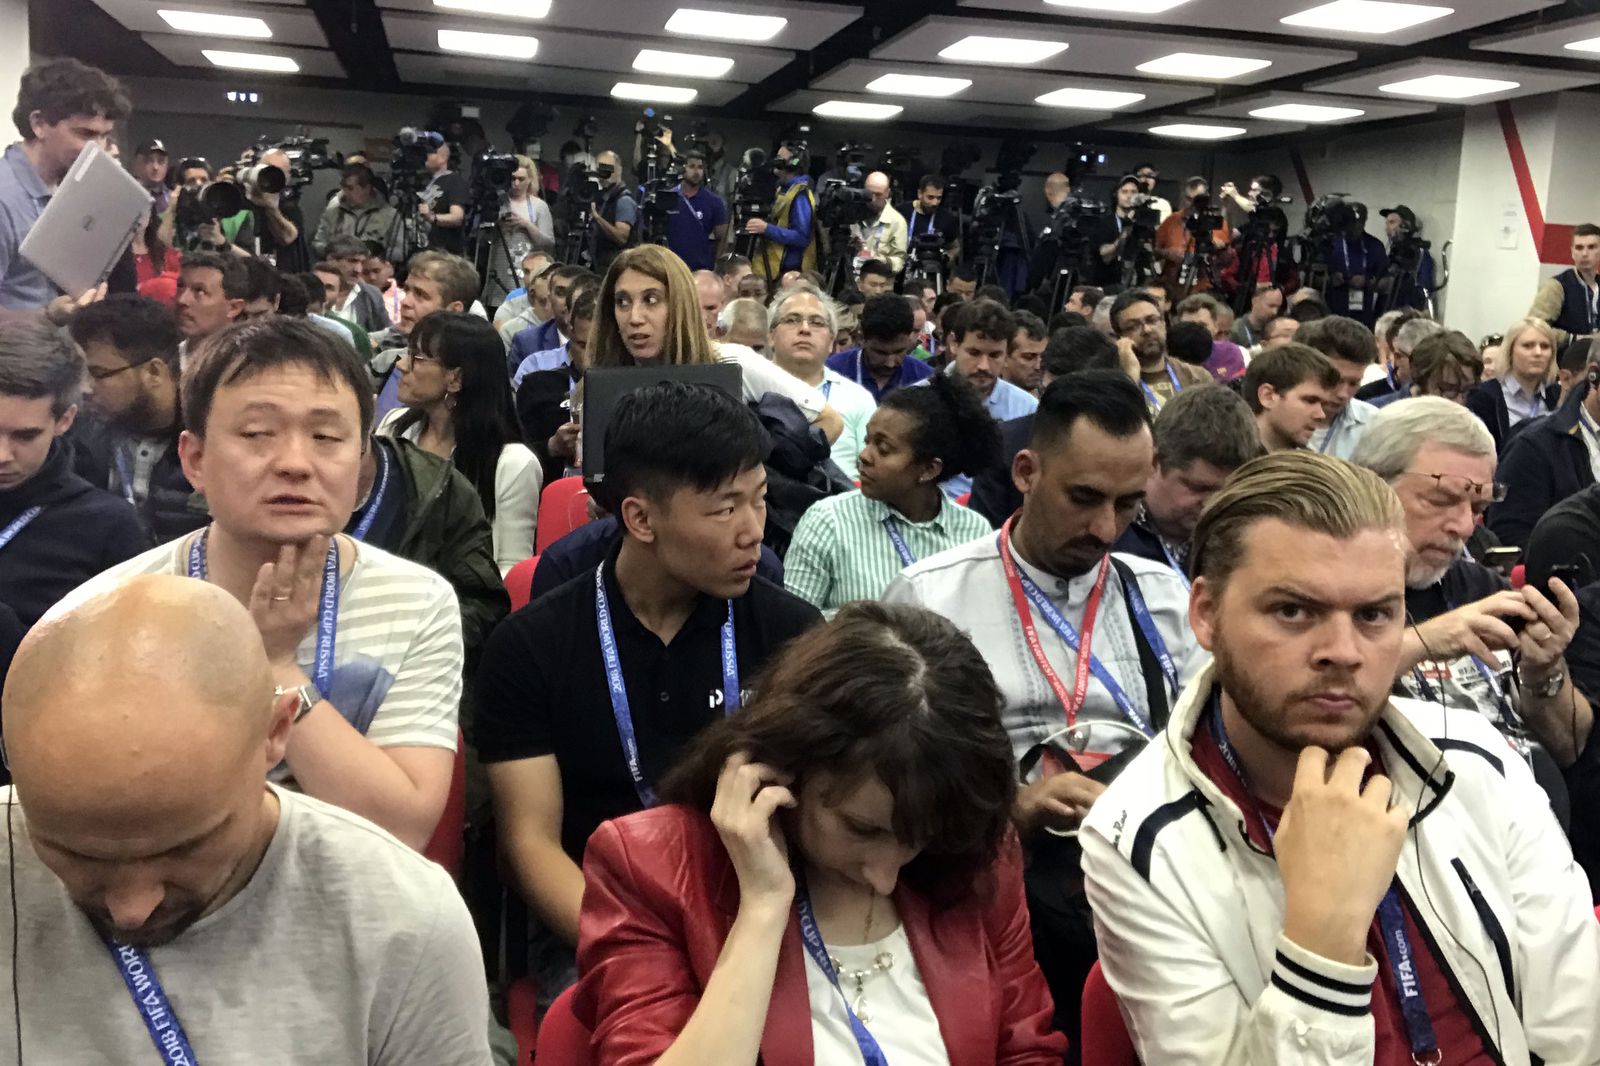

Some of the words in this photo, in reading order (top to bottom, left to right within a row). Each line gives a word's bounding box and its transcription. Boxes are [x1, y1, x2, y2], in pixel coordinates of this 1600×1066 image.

[324, 570, 336, 609] WORLD
[322, 609, 334, 635] CUP
[600, 611, 614, 647] WORLD
[317, 635, 331, 679] RUSSIA
[606, 645, 616, 669] FIFA
[724, 639, 735, 677] RUSSIA
[612, 668, 623, 693] 2018
[1395, 929, 1419, 998] FIFA.com
[143, 990, 170, 1031] FIFA
